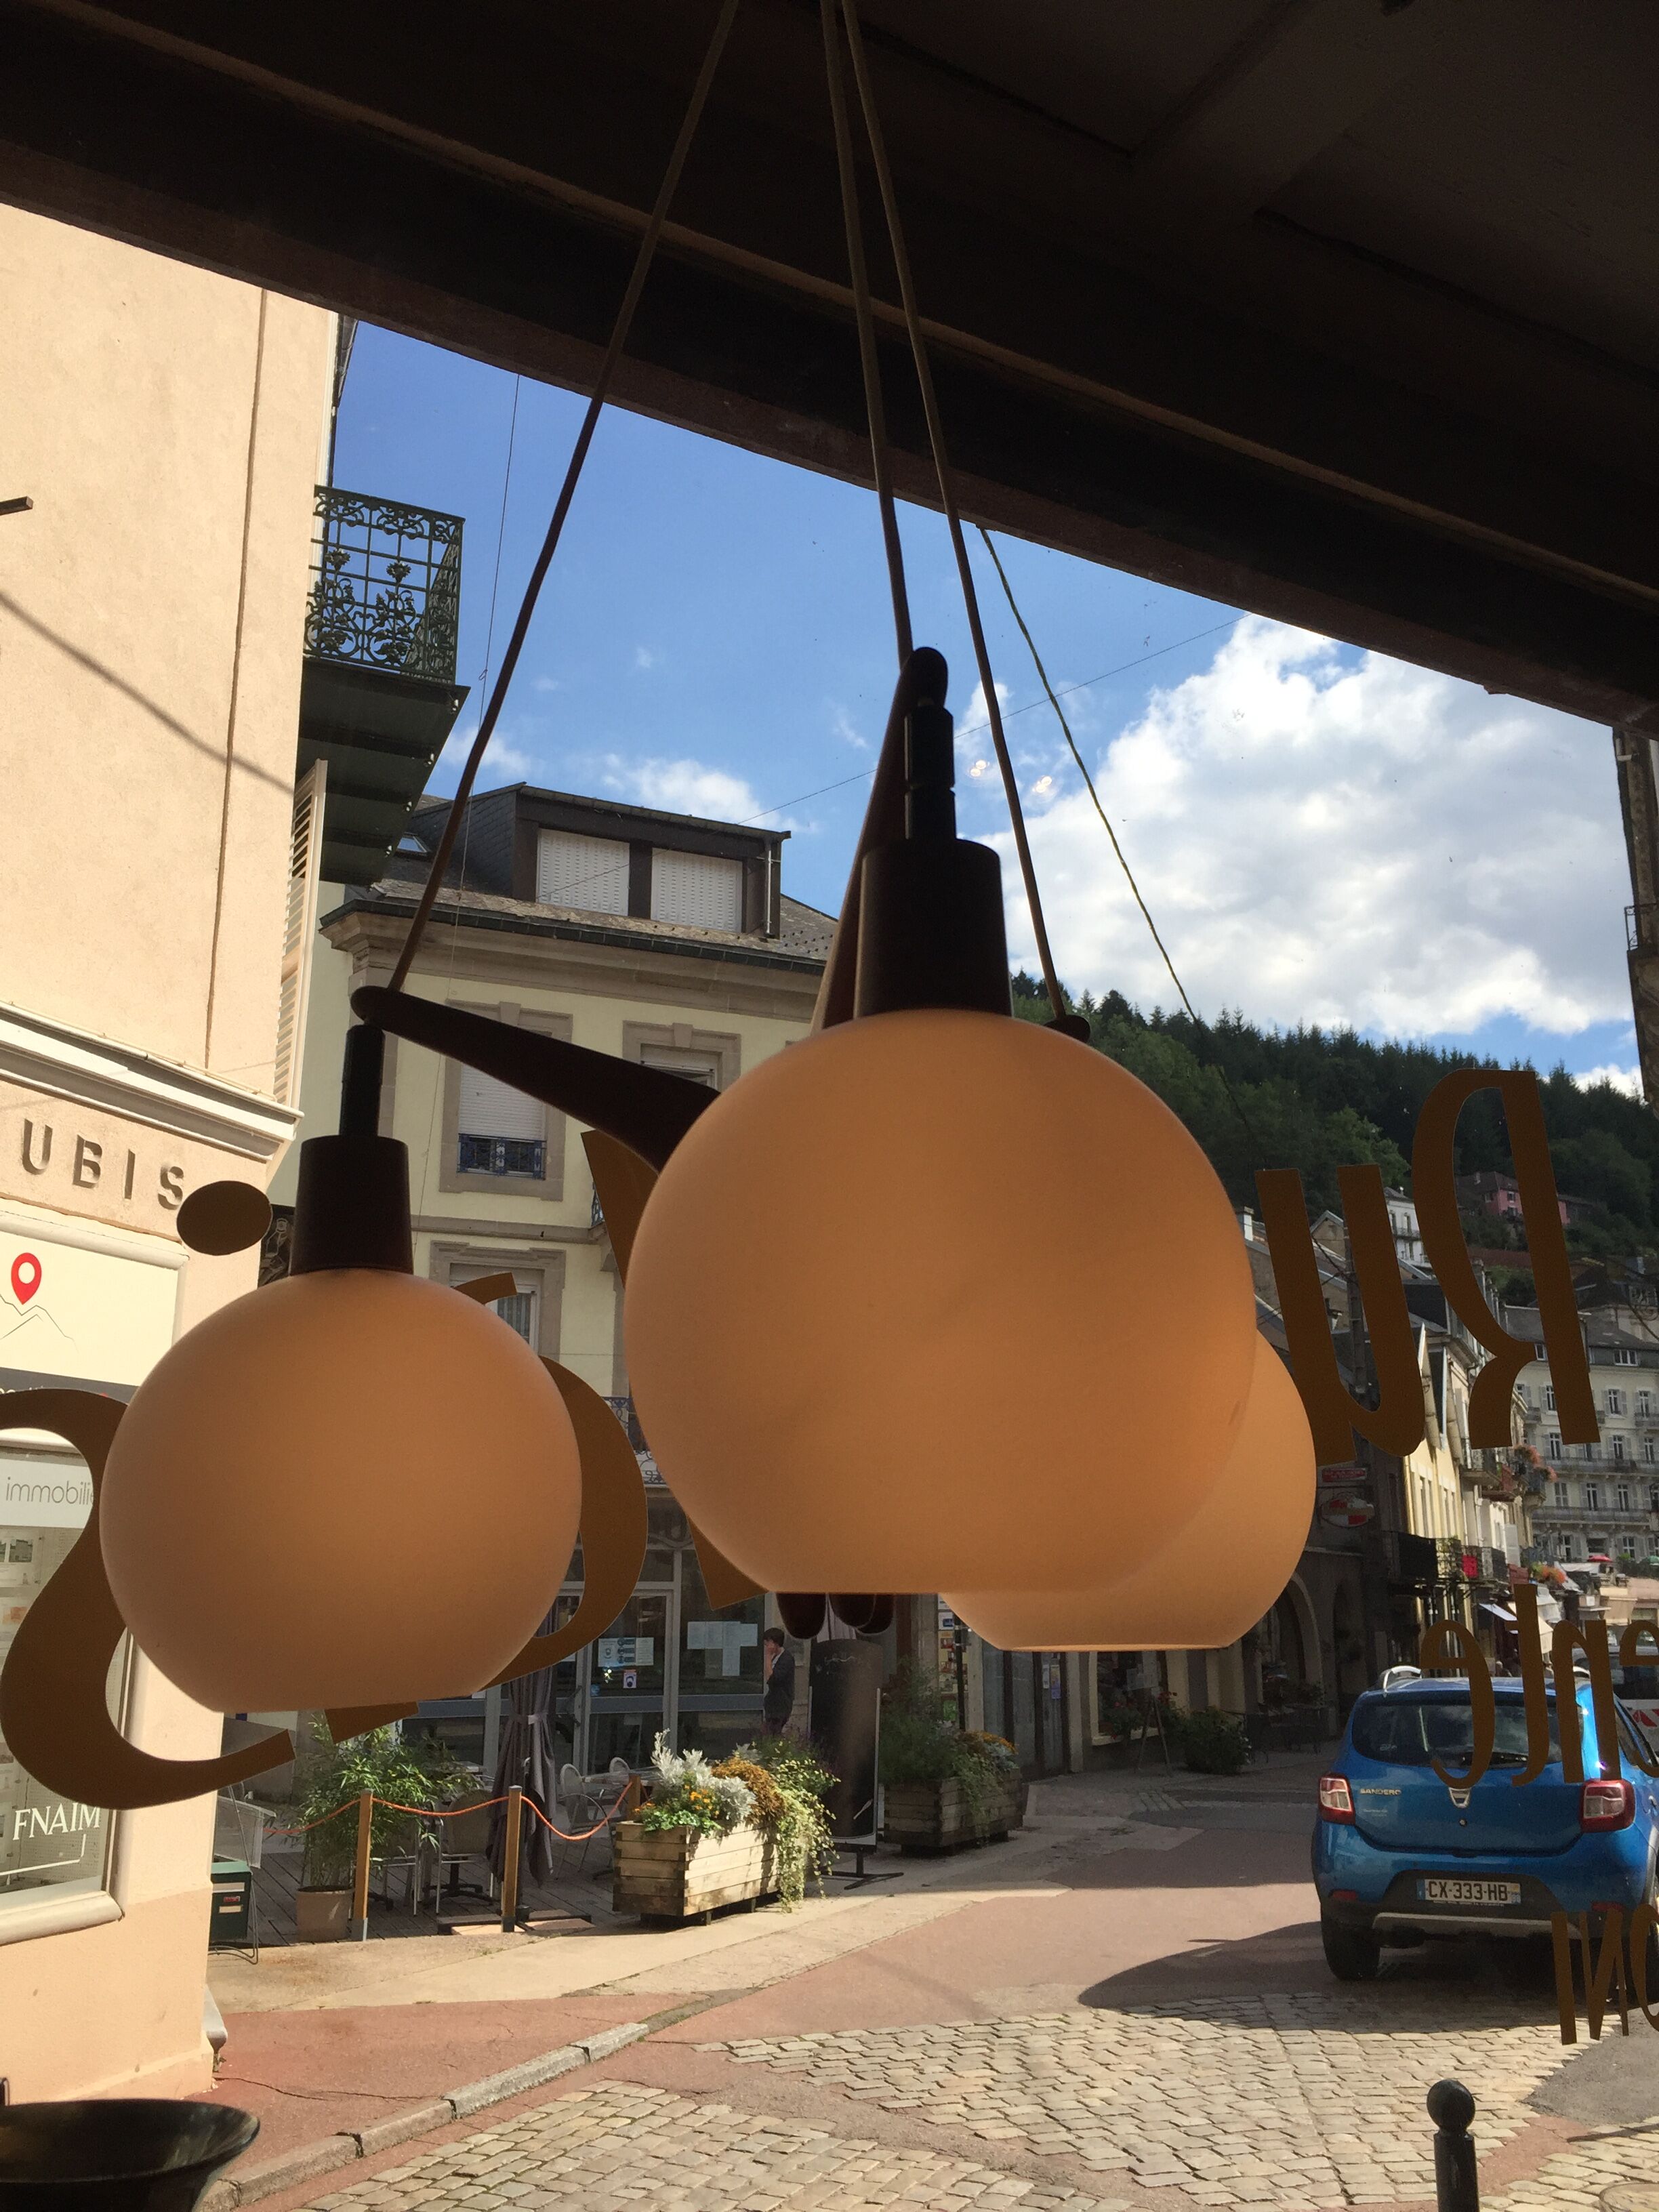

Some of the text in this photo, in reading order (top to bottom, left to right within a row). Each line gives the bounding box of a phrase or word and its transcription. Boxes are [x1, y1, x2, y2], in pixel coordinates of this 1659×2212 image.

[22, 1118, 184, 1210] UBIS
[1359, 1788, 1402, 1796] SANDERO
[12, 1802, 101, 1841] FNAIM
[1428, 1881, 1509, 1902] CX-333-HB
